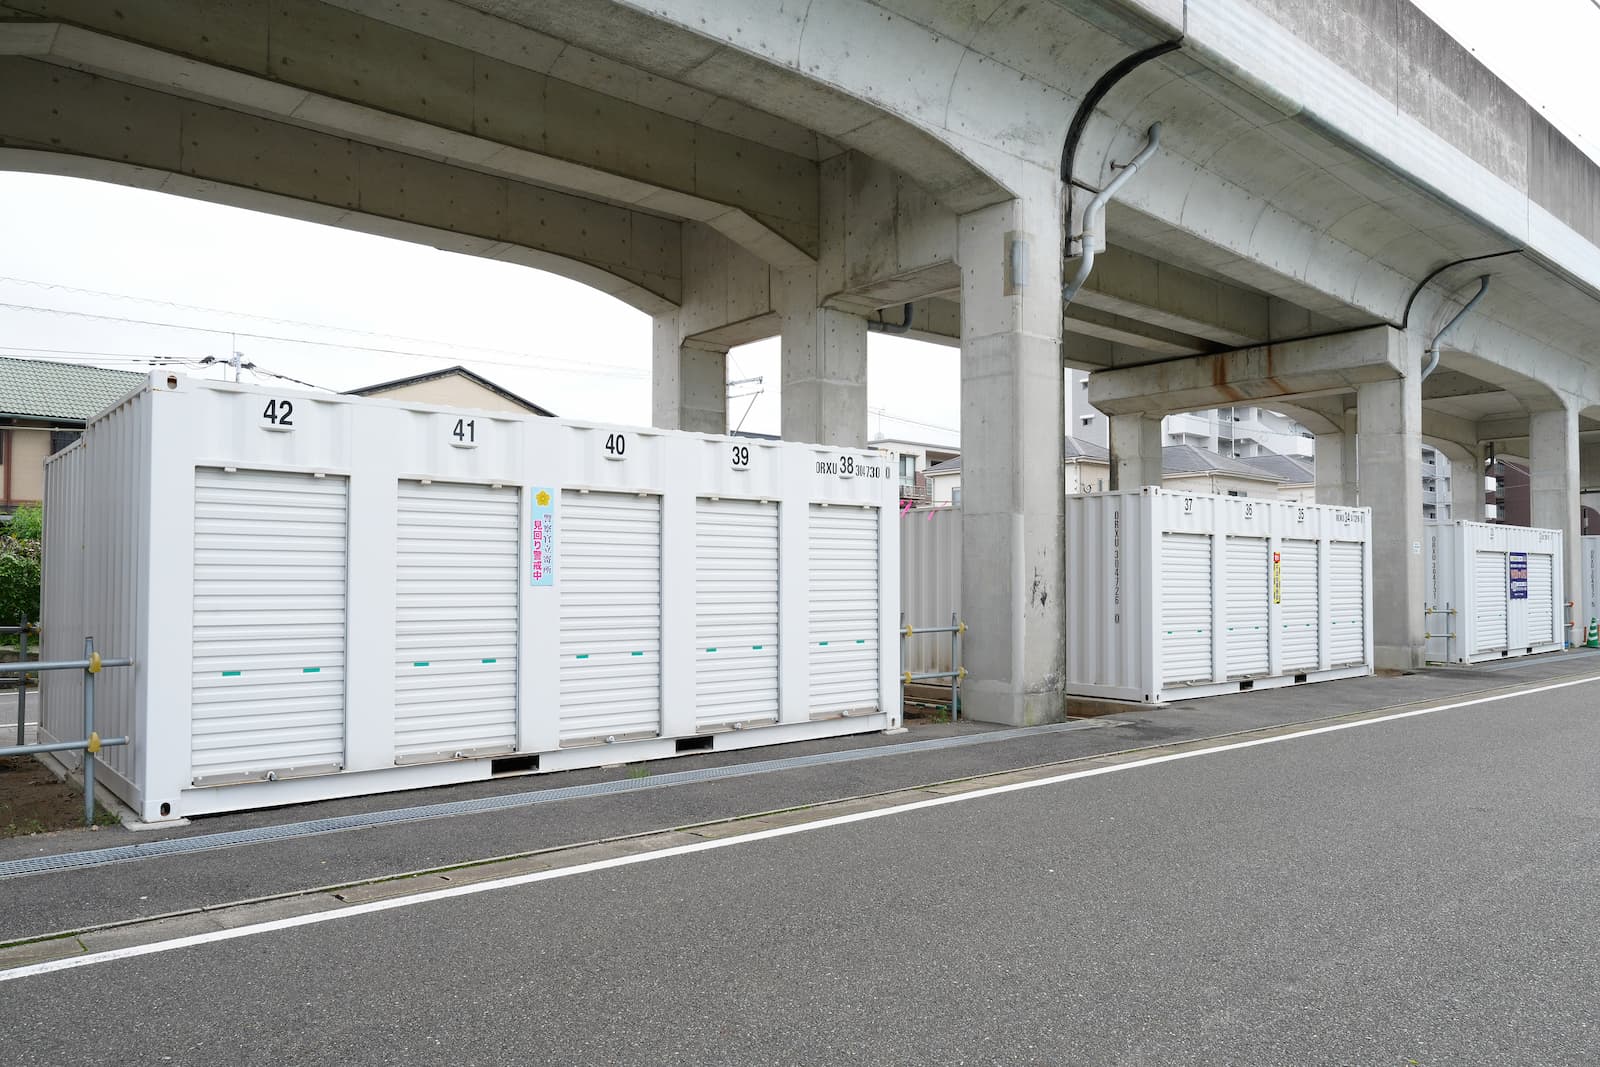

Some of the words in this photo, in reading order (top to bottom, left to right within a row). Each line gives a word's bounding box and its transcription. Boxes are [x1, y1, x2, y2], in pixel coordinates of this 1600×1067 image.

[263, 399, 294, 426] 42
[453, 418, 475, 443] 41
[605, 433, 626, 456] 40
[731, 445, 750, 467] 39
[839, 456, 854, 475] 38
[815, 461, 838, 475] ORXU
[1184, 497, 1193, 511] 37
[533, 520, 543, 581] 見回り警戒中
